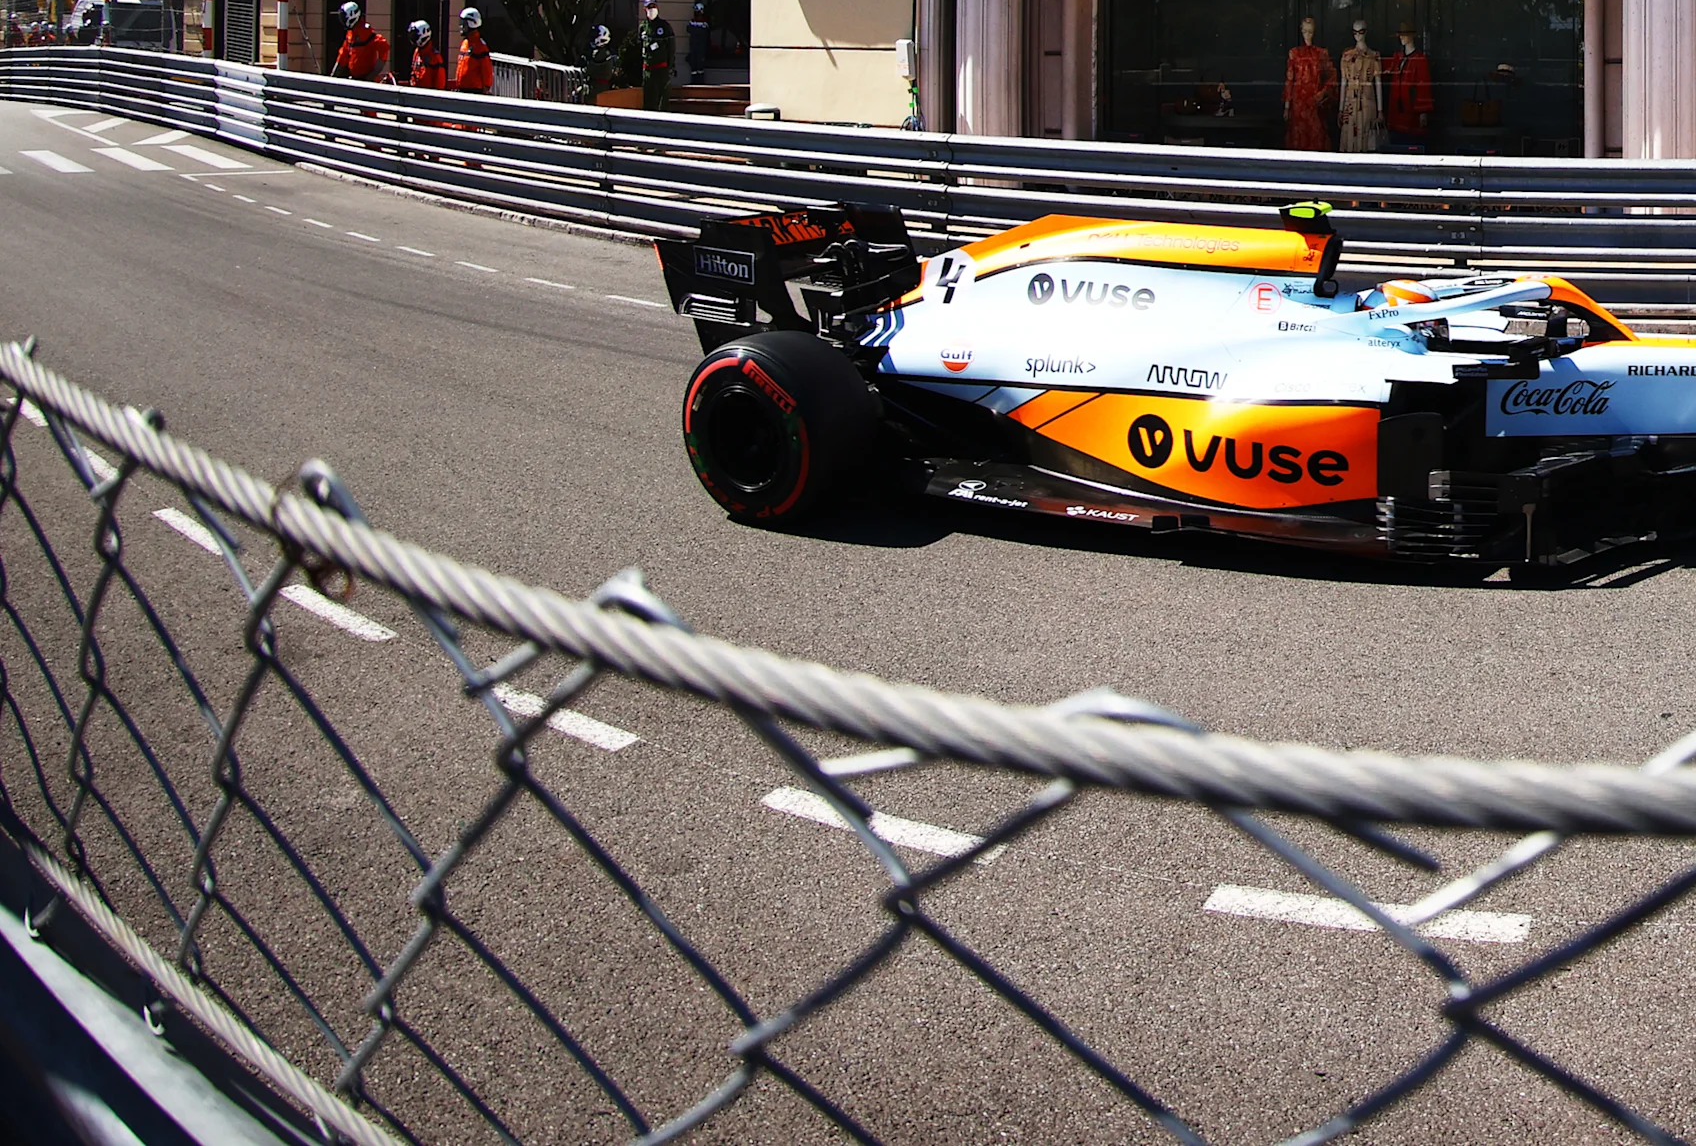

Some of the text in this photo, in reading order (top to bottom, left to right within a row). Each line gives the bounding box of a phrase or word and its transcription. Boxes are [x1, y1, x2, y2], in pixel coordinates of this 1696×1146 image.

[1136, 233, 1241, 254] Technologies
[700, 255, 749, 279] Hilton
[935, 257, 967, 304] 4
[1368, 309, 1400, 320] FxPro
[1368, 338, 1401, 348] alteryx
[940, 348, 973, 361] Gulf
[741, 359, 798, 414] PIRELLI
[1501, 379, 1618, 416] Coca-Cola
[1086, 509, 1139, 522] KAUST
